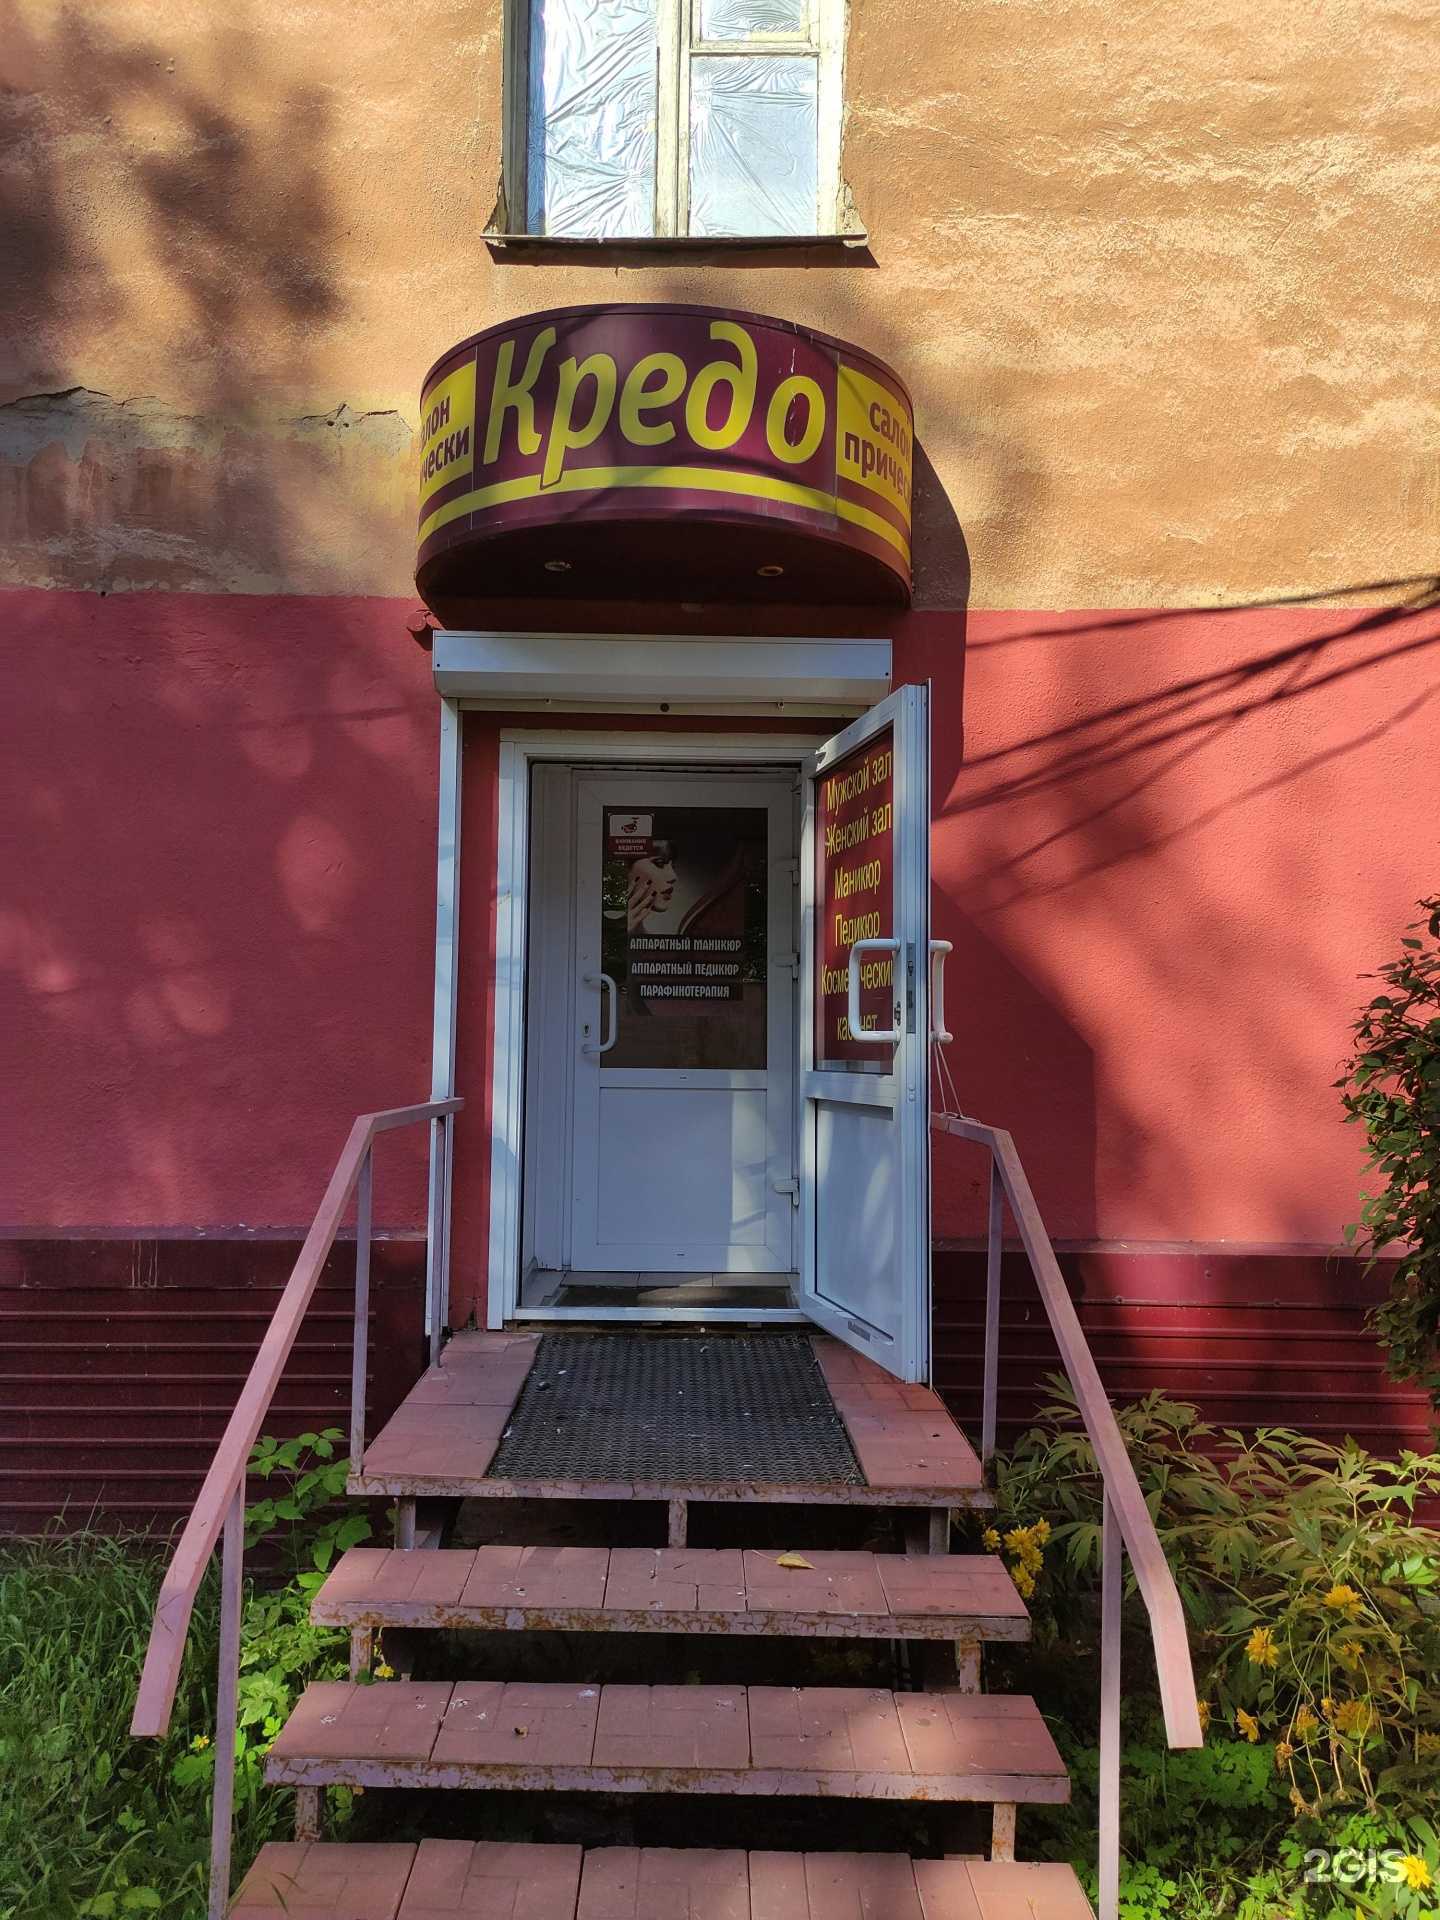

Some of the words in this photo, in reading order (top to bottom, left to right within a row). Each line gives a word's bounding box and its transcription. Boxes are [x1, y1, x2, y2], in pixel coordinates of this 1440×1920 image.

[420, 395, 451, 452] алон
[483, 321, 826, 486] Кредо
[422, 426, 470, 484] чески
[827, 756, 869, 816] Мужской
[872, 751, 892, 786] зал
[825, 807, 869, 859] Женский
[872, 803, 892, 837] зал
[834, 859, 881, 900] Маникюр
[630, 937, 691, 951] АППАРАТНЫЙ
[693, 939, 742, 952] МАНИКЮР
[835, 911, 880, 950] Педикюр
[631, 962, 692, 975] АППАРАТНЫЙ
[694, 963, 740, 977] ПЕДИКЮР
[821, 960, 894, 996] Космечески
[640, 984, 730, 998] ПАРАФИНОТЕРАПИЯ
[837, 1014, 878, 1041] канет
